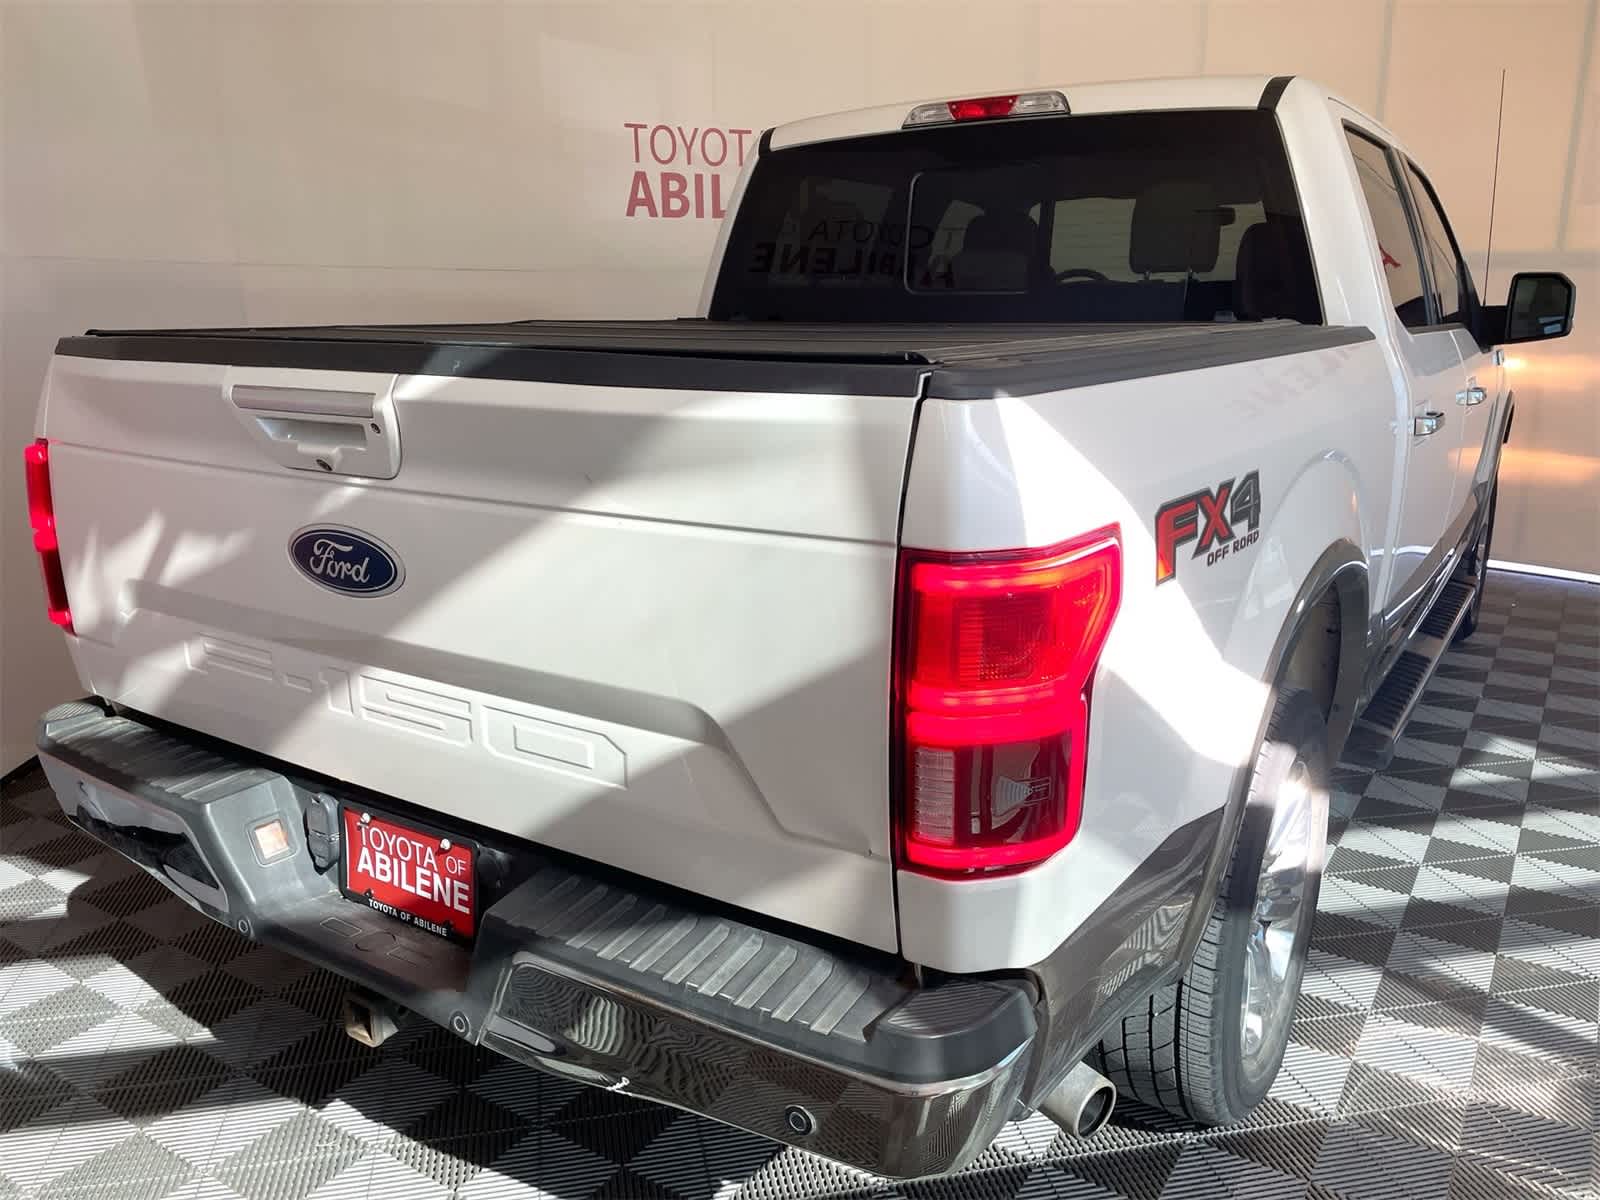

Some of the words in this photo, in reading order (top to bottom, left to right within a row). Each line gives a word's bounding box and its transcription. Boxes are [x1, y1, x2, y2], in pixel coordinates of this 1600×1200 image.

[624, 123, 752, 167] TOYOT
[625, 171, 727, 219] ABIL
[1154, 469, 1261, 587] FX4
[1206, 544, 1230, 567] OFF
[1232, 530, 1260, 554] ROAD
[309, 538, 371, 584] Ford
[184, 632, 628, 790] F-150
[356, 820, 438, 871] TOYOTA
[445, 855, 467, 876] OF
[356, 846, 470, 915] ABILENE
[368, 899, 398, 917] TOYOTA
[400, 911, 411, 923] OF
[413, 916, 448, 938] ABILENE
